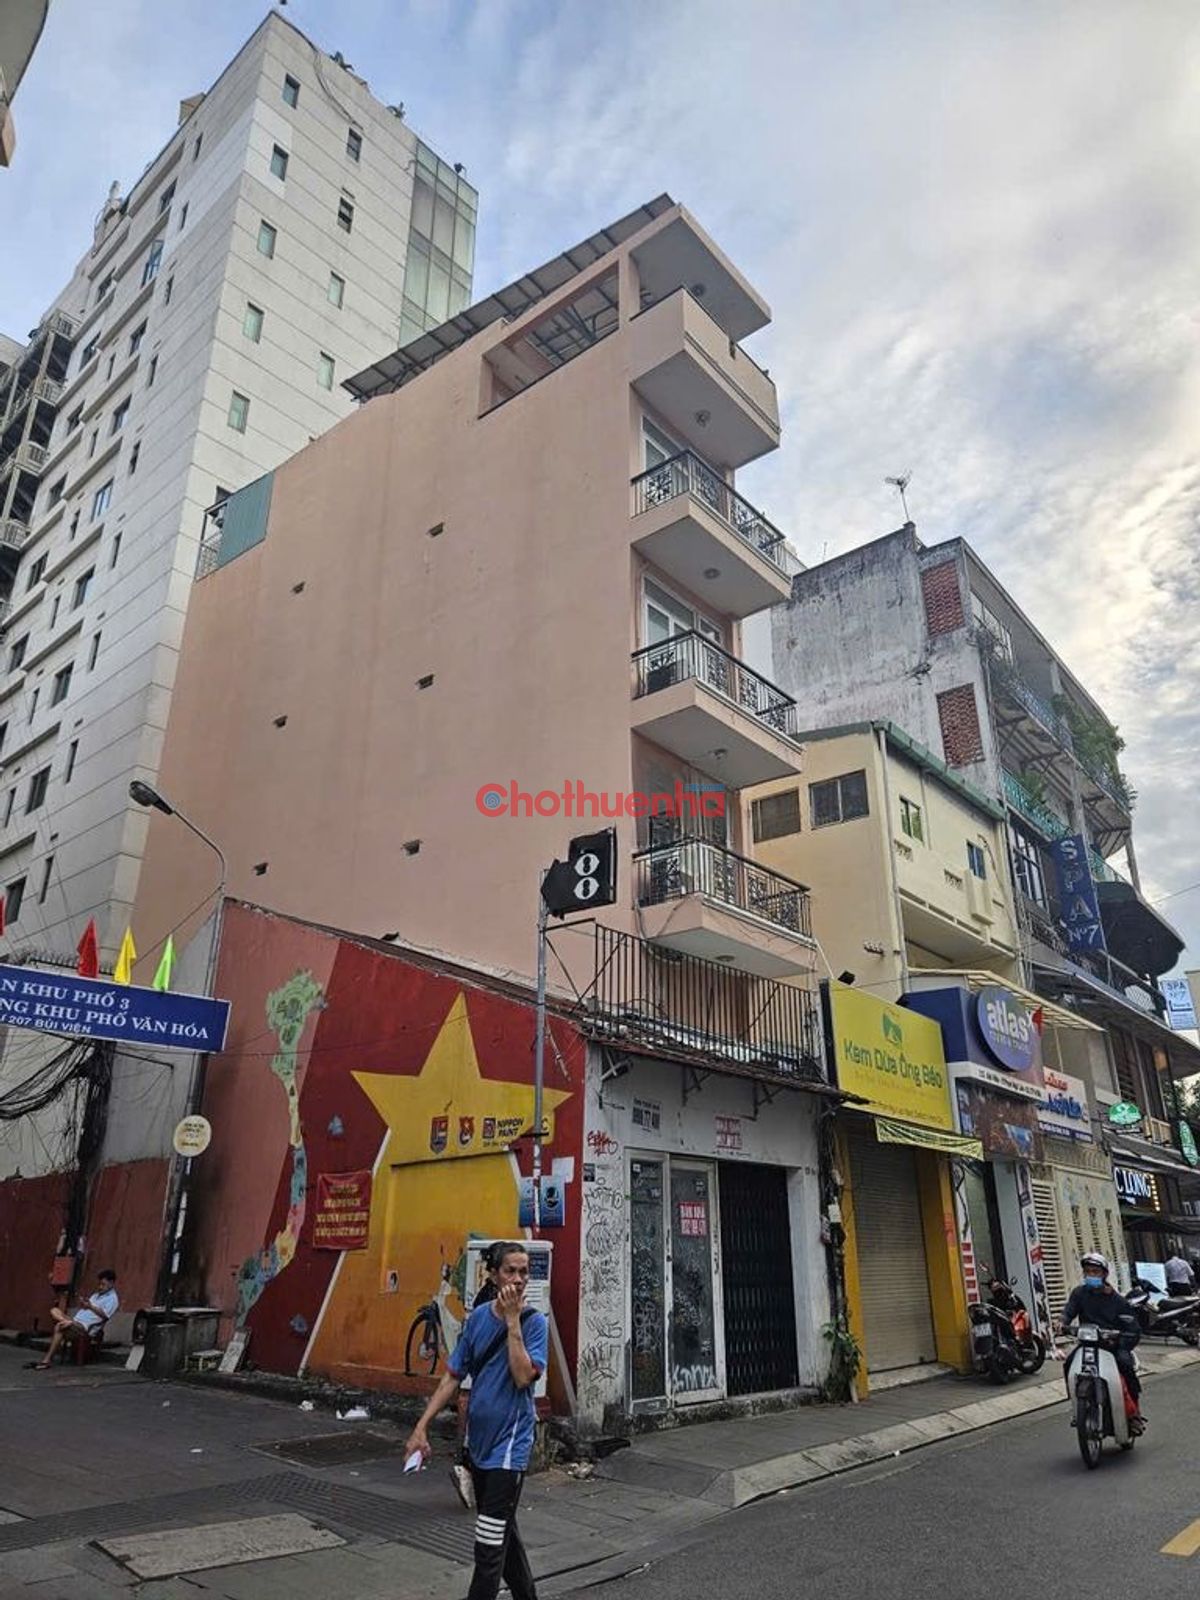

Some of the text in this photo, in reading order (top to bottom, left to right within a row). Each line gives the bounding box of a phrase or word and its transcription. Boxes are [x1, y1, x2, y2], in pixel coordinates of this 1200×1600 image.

[22, 981, 69, 999] KHU
[73, 990, 116, 1008] PHỐ
[119, 997, 131, 1010] 3
[34, 1003, 81, 1020] KHU
[85, 1010, 128, 1027] PHỐ
[132, 1016, 168, 1032] VĂN
[171, 1021, 210, 1039] HÓA
[986, 999, 1030, 1042] atlas
[844, 1039, 873, 1067] Kem
[1123, 1169, 1152, 1198] LONG
